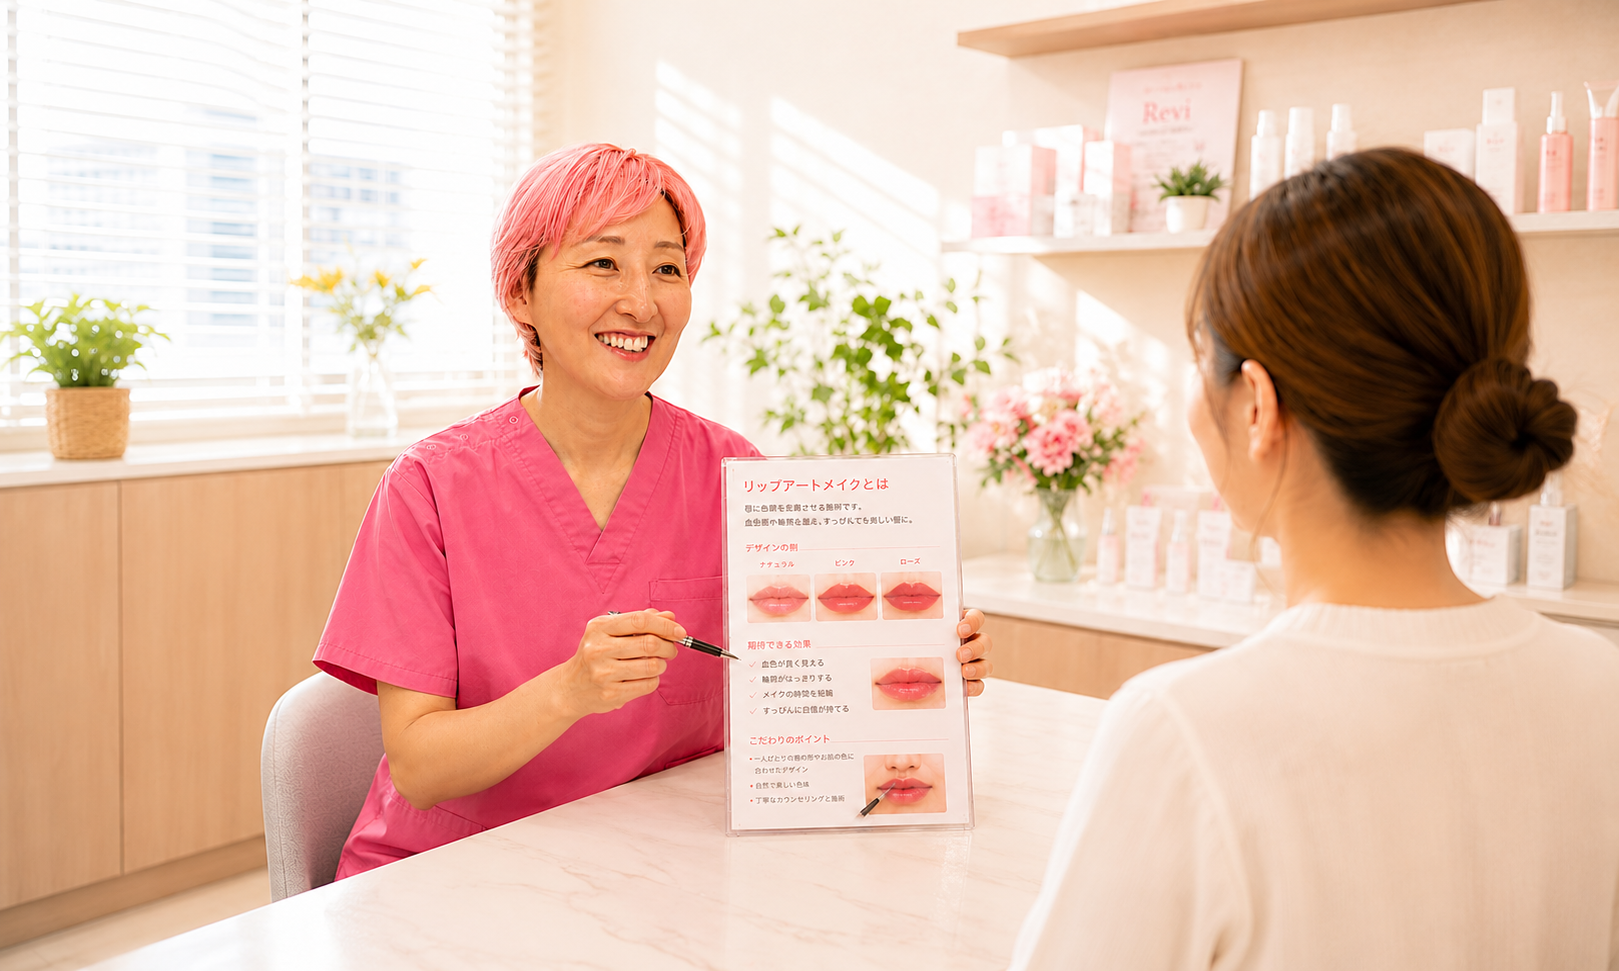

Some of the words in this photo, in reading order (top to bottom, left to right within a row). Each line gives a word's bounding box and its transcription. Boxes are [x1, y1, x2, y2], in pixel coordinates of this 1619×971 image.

[1143, 98, 1192, 124] Revi
[743, 477, 889, 493] リップアートメイクとは
[900, 557, 921, 566] ローズ
[749, 734, 831, 746] こだわりのポイント
